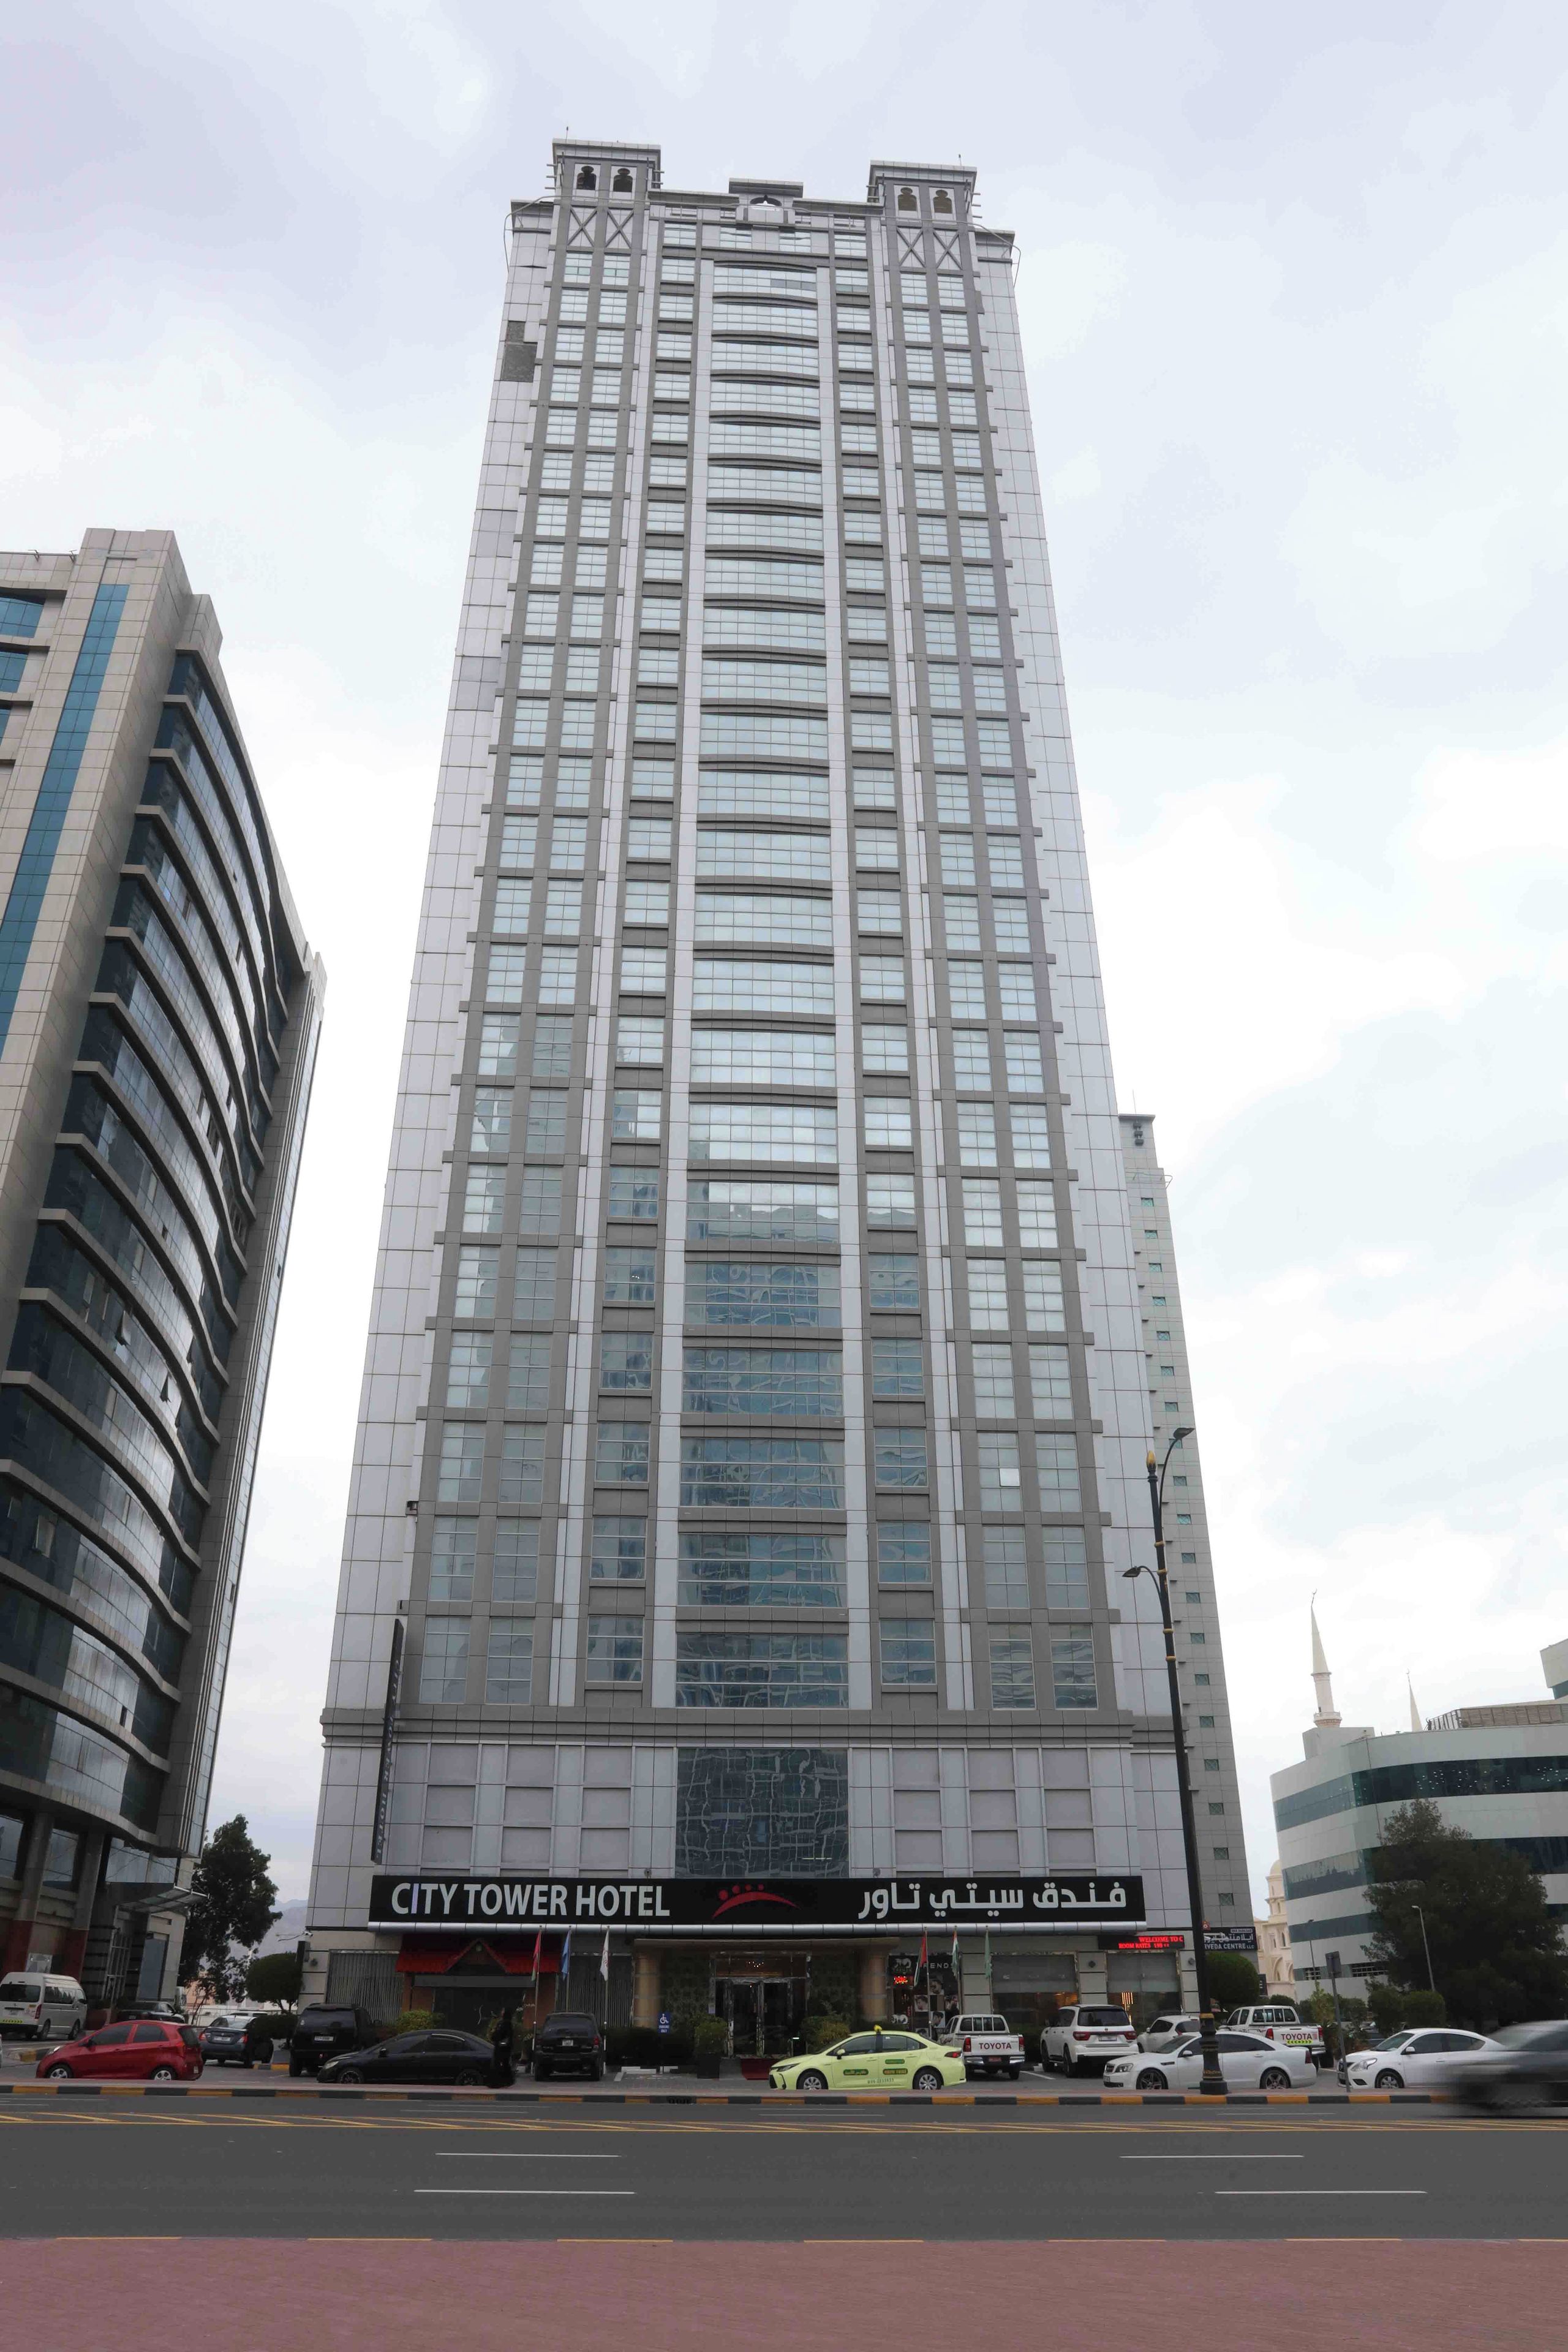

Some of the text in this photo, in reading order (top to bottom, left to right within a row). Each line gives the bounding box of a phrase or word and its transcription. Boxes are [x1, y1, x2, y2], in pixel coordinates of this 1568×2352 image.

[391, 1882, 671, 1917] CITY TOWER HOTEL
[858, 1882, 1126, 1919] فندق سيتي تاور
